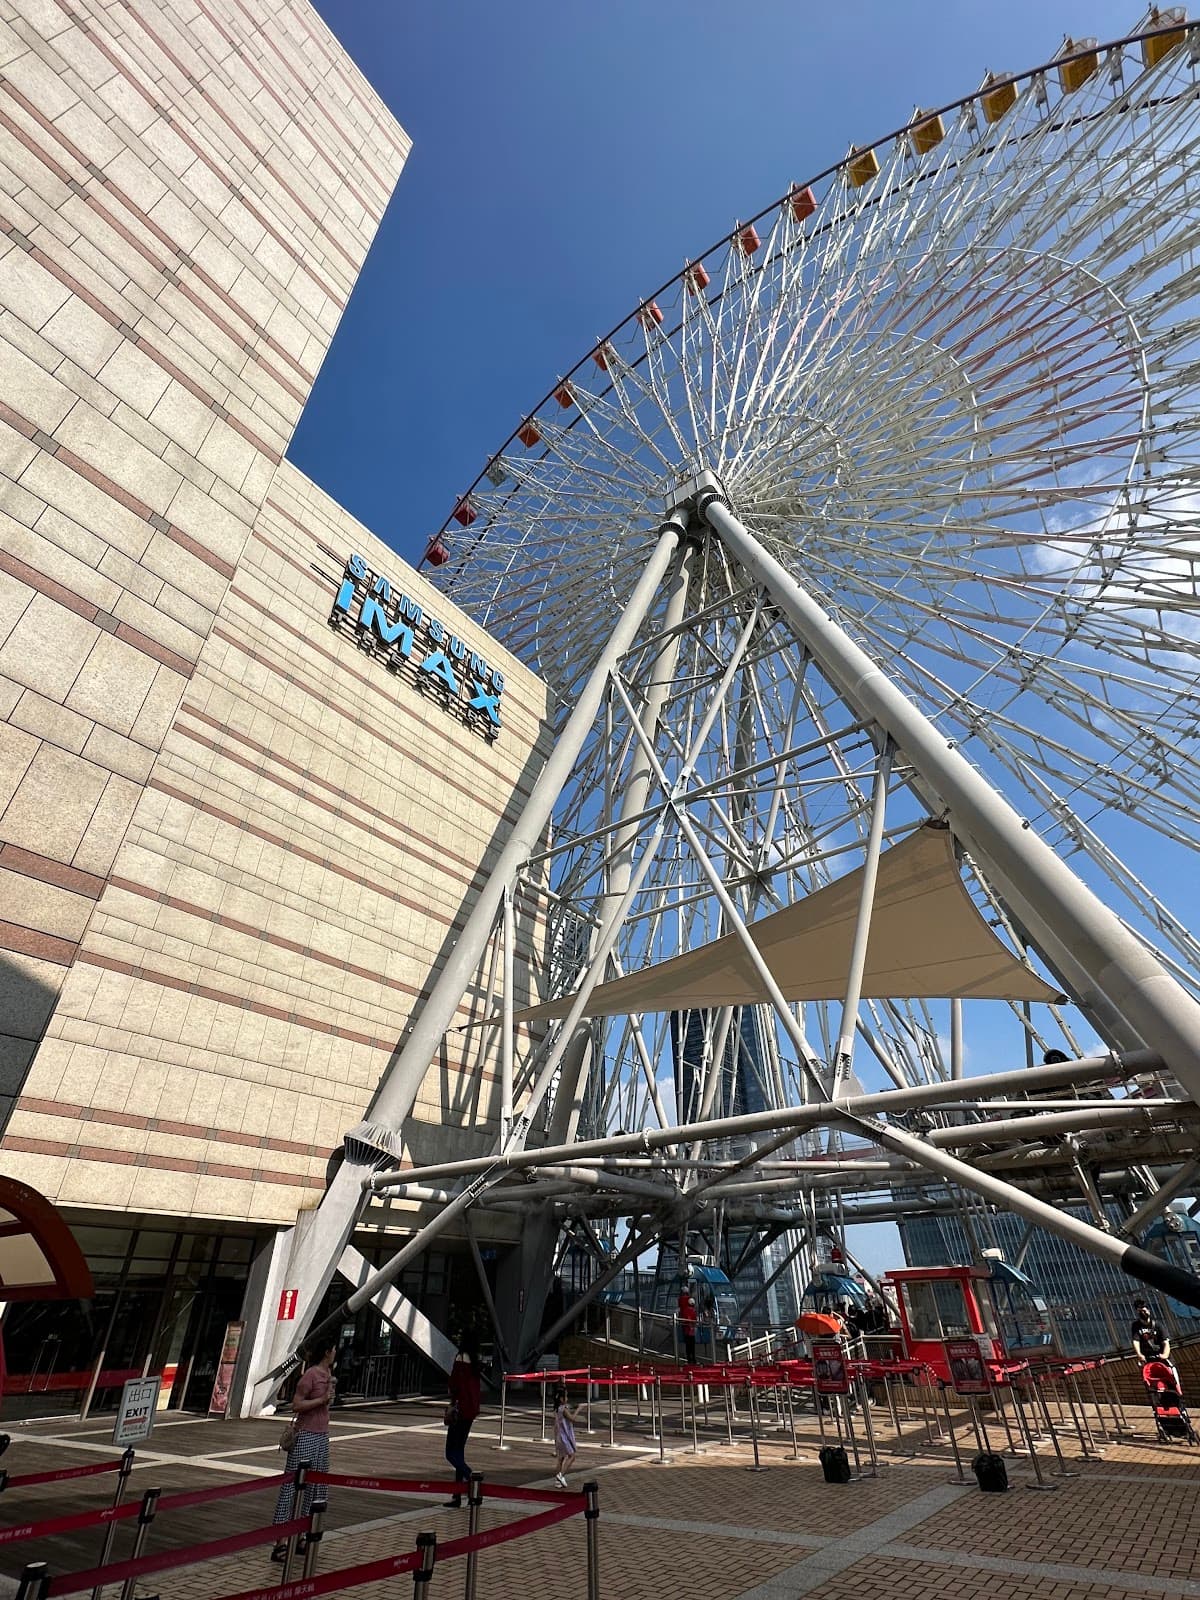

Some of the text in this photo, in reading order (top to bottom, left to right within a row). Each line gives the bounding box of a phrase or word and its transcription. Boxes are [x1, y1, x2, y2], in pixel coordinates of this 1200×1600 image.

[336, 578, 501, 727] IMAX
[349, 554, 505, 693] SAMSUNG
[125, 1406, 150, 1418] EXIT
[128, 1388, 152, 1402] 出口
